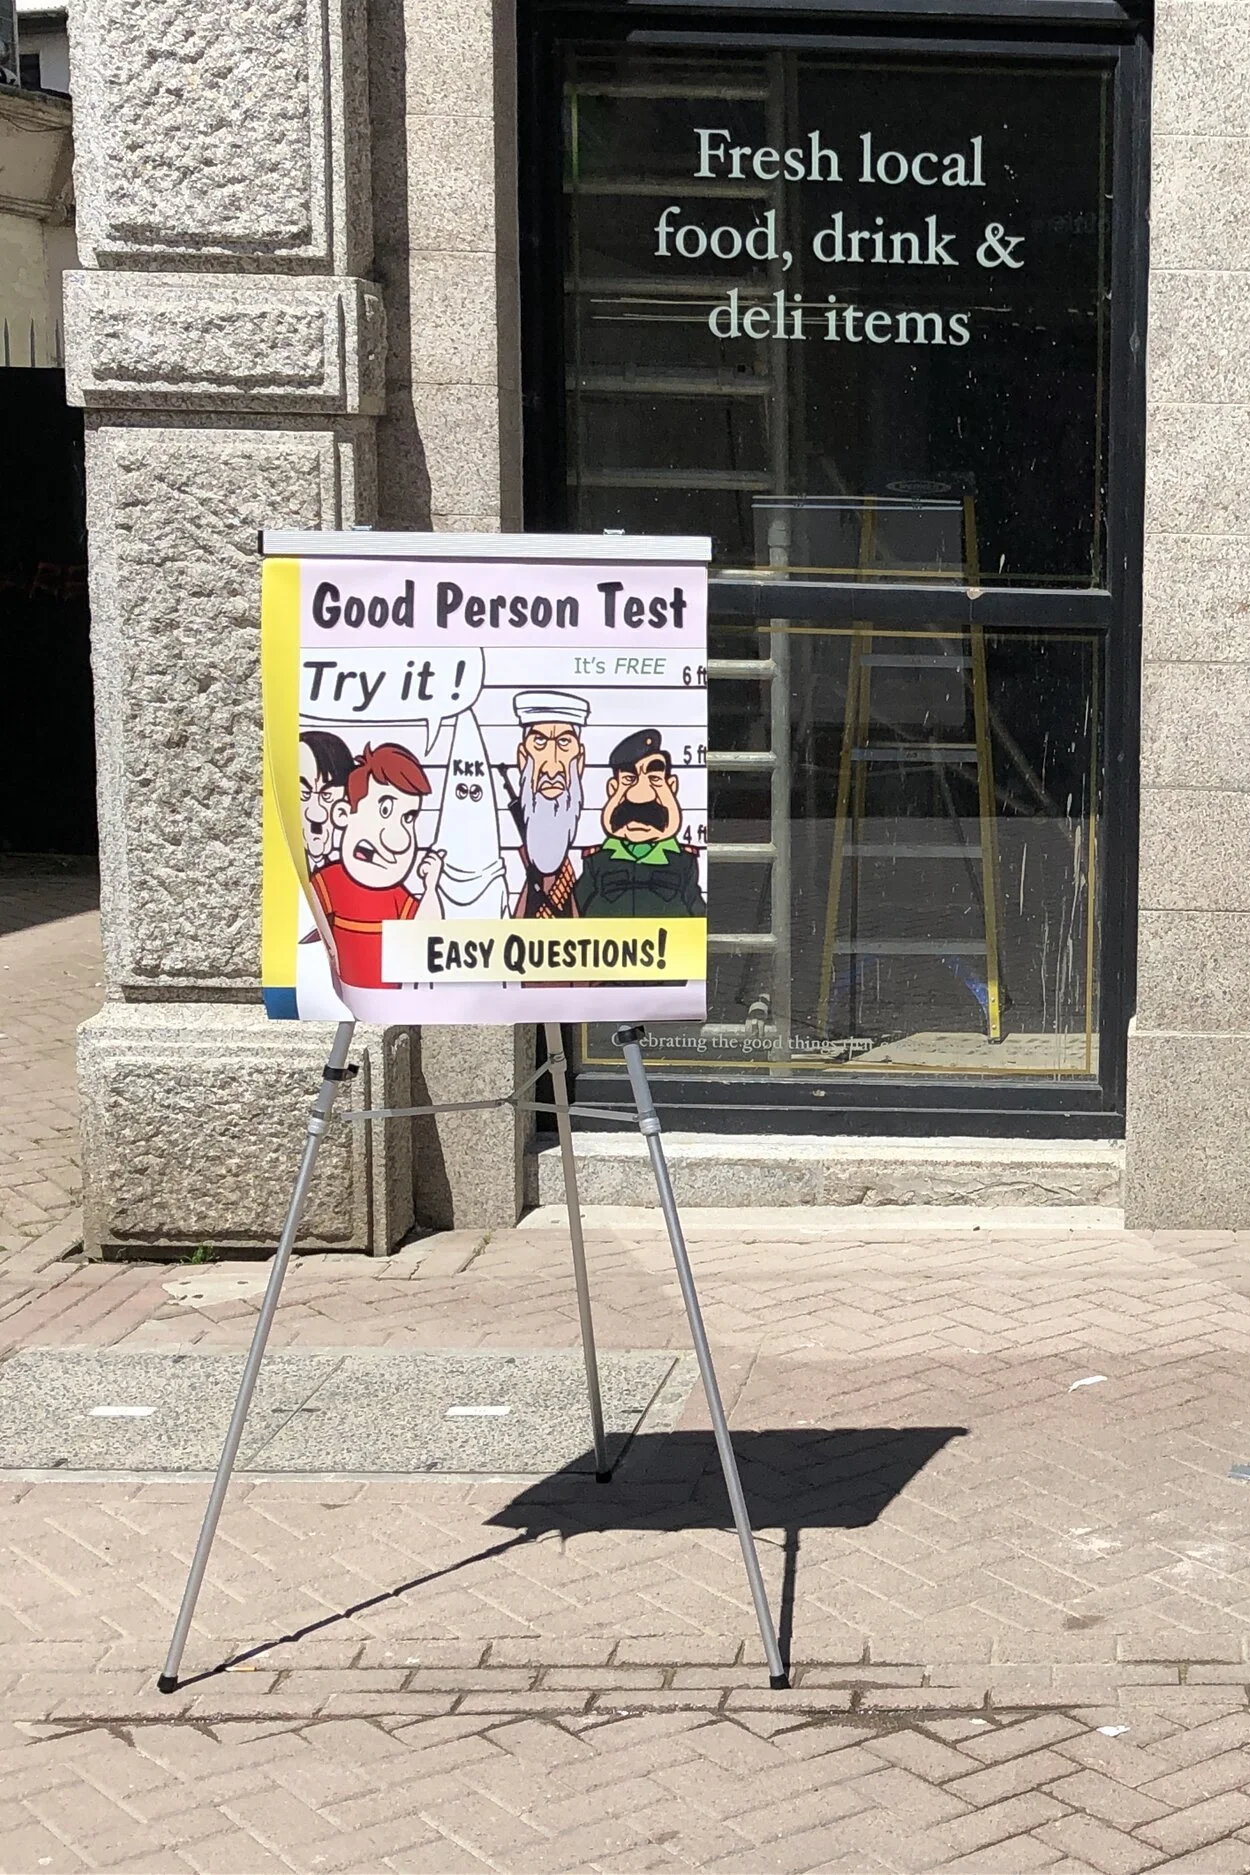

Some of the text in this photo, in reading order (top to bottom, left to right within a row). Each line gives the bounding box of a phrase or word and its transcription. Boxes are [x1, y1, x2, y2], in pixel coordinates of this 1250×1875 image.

[694, 127, 985, 187] Fresh local
[654, 207, 1024, 270] food, drink &
[708, 289, 970, 346] deli items
[313, 579, 686, 630] Good Person Test
[303, 661, 435, 711] Try it
[574, 657, 666, 675] It's FREE
[683, 666, 707, 686] 6 ft
[684, 745, 707, 765] 5 ft
[683, 826, 691, 843] 4
[428, 928, 668, 973] EASY QUESTIONS!
[712, 1035, 738, 1048] the
[742, 1036, 782, 1052] good
